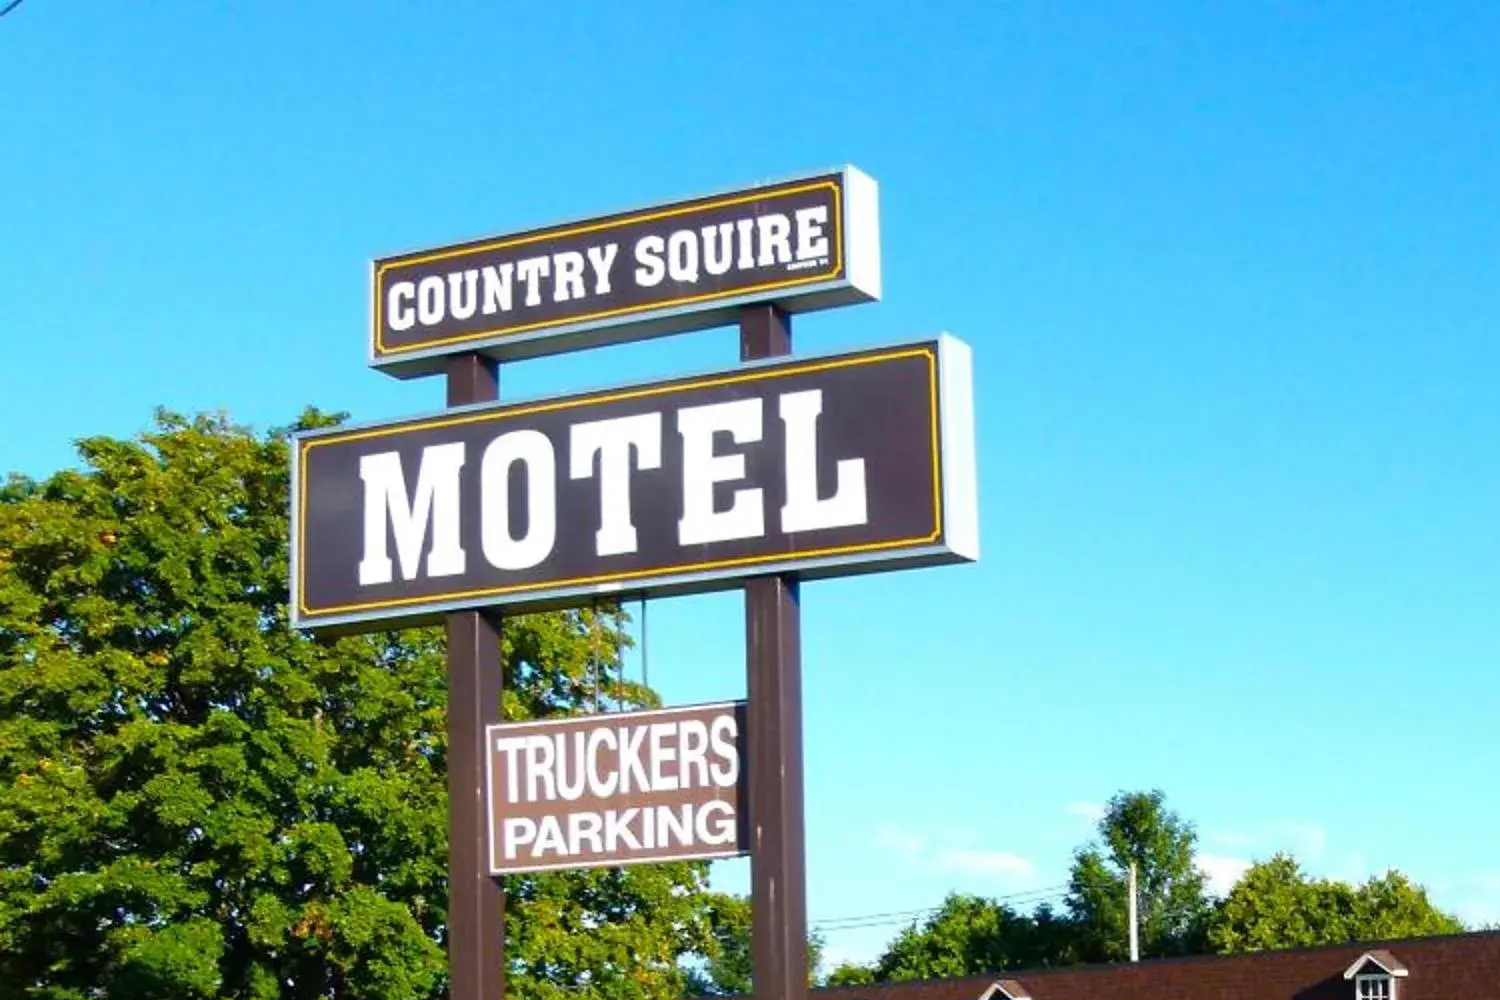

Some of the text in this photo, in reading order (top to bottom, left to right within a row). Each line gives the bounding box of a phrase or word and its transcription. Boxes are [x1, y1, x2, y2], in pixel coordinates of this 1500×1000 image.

[387, 205, 828, 331] COUNTRY SQUIRE
[358, 388, 868, 585] MOTEL
[497, 715, 739, 803] TRUCKERS
[504, 799, 737, 859] PARKING
